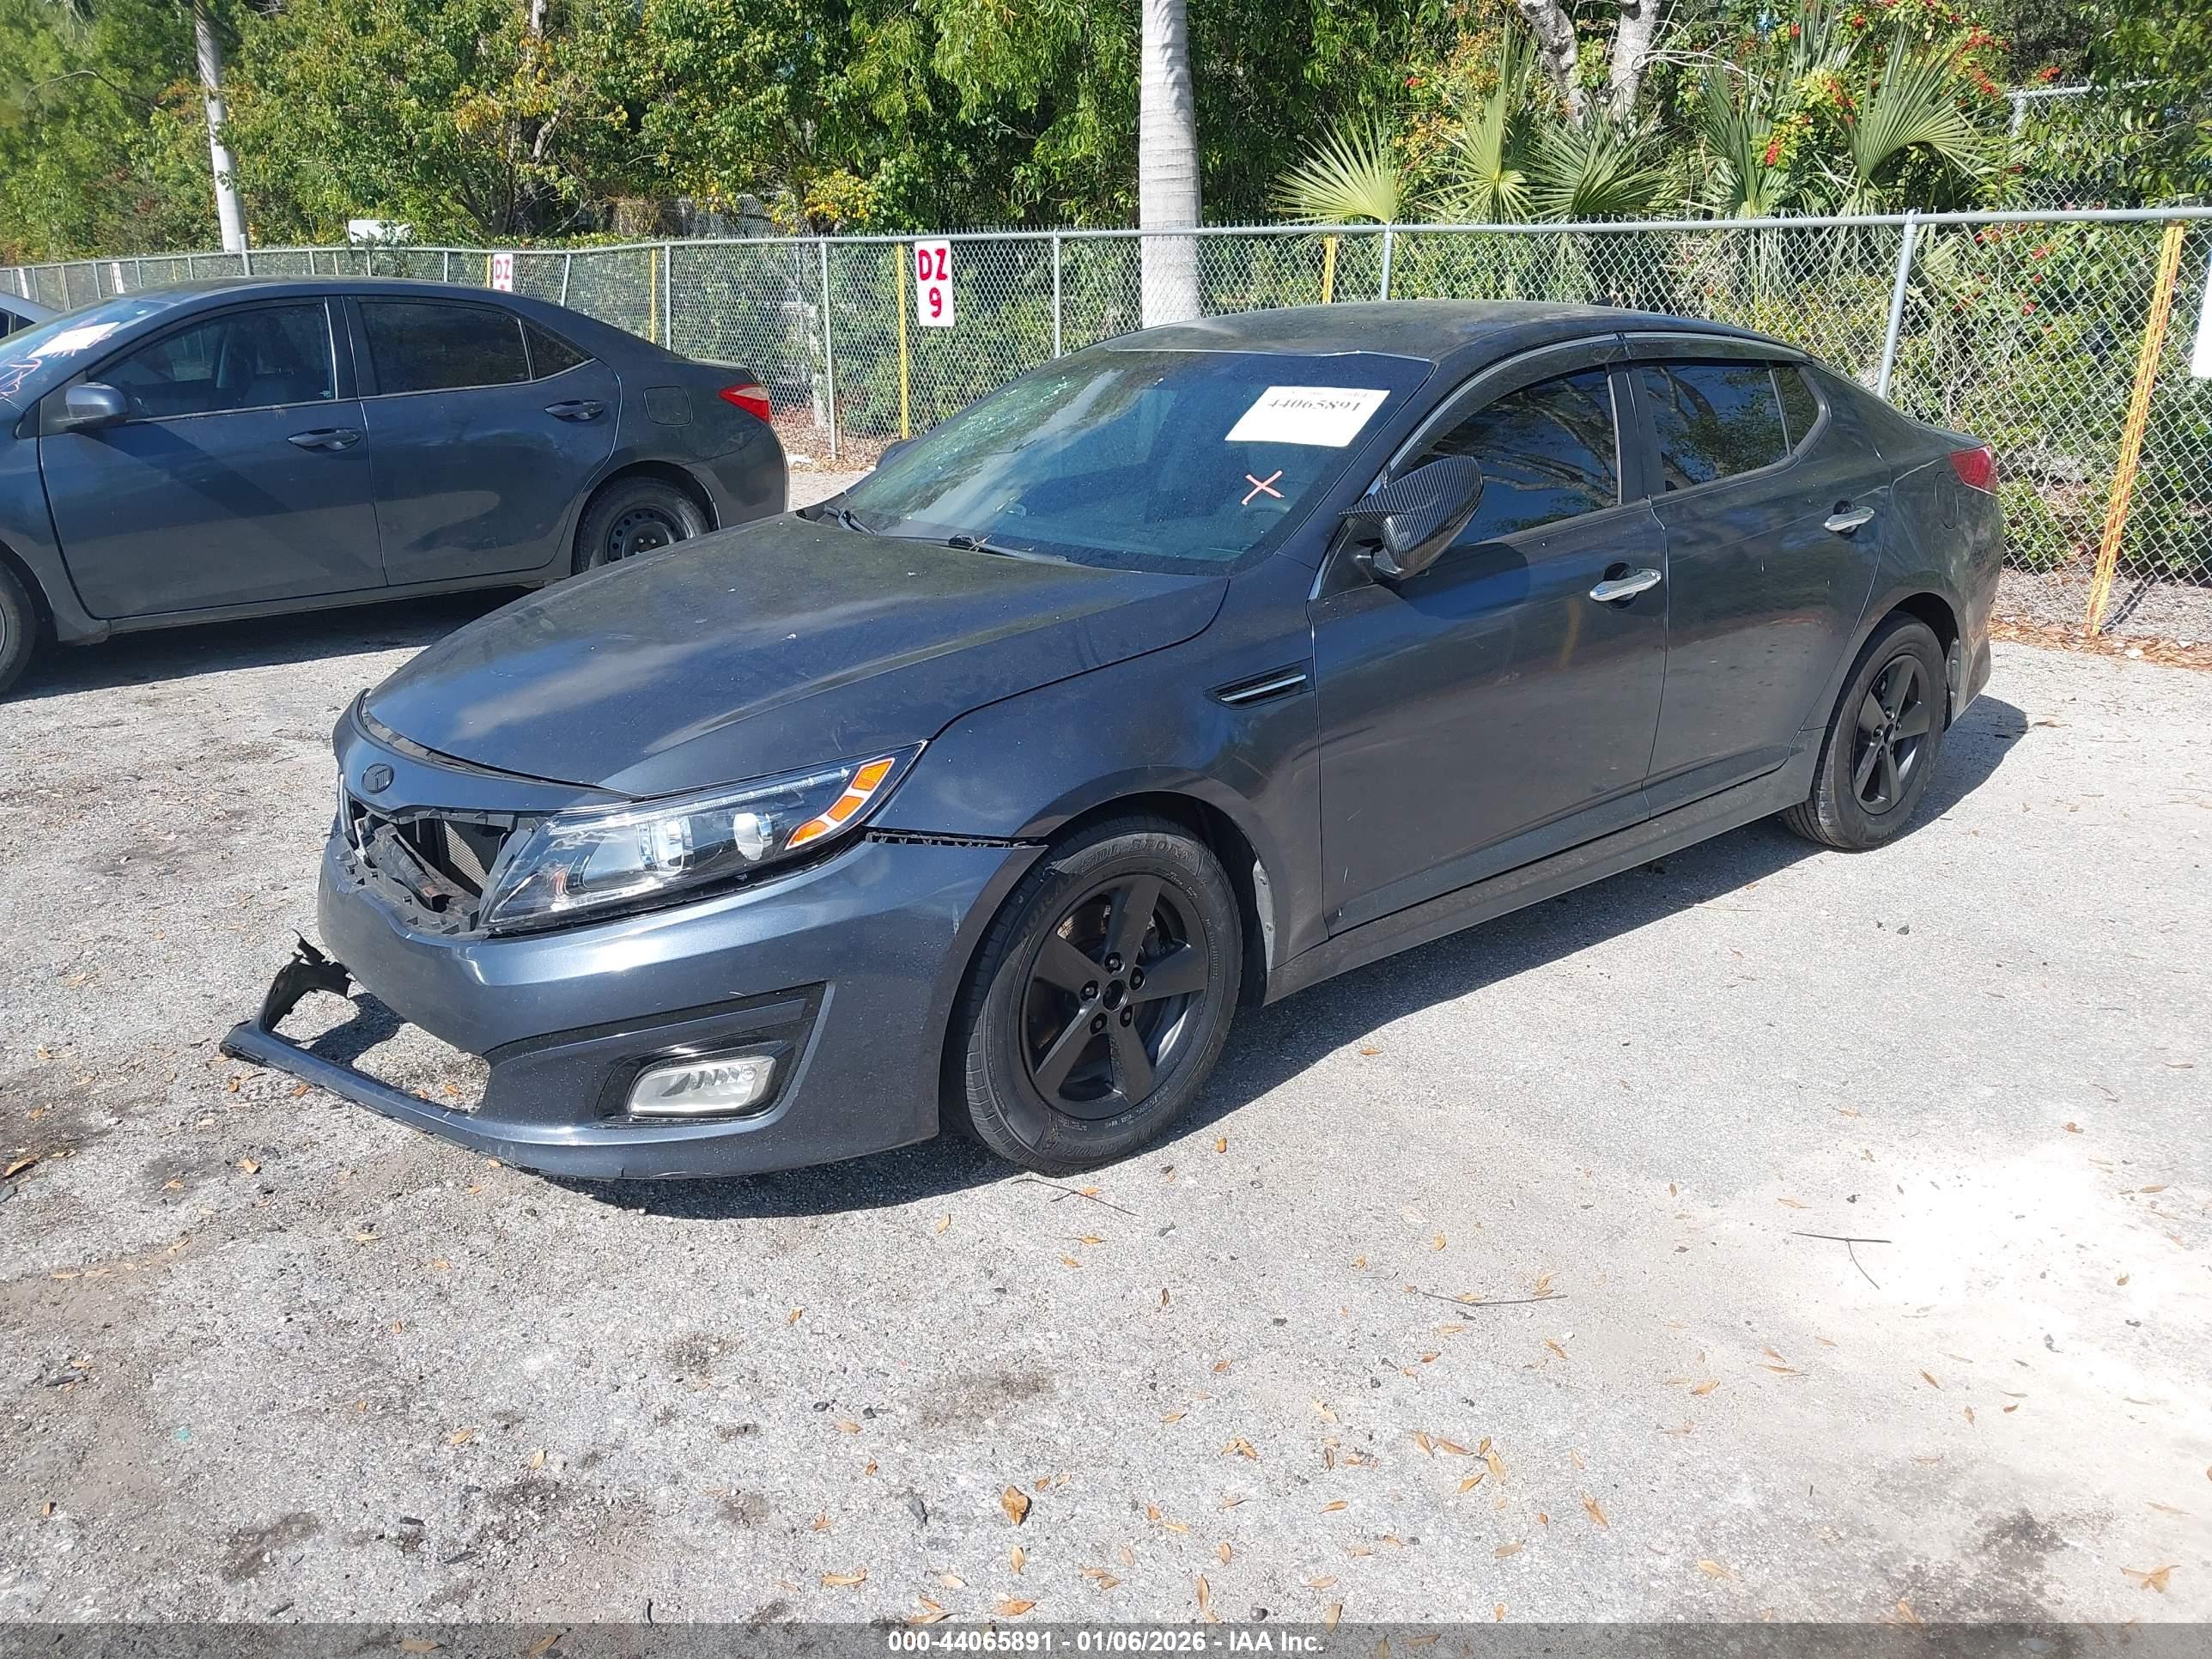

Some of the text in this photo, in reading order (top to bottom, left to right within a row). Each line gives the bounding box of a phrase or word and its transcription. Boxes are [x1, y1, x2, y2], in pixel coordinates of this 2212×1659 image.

[918, 248, 948, 281] DZ
[928, 287, 942, 319] 9
[1267, 398, 1361, 411] 44065891
